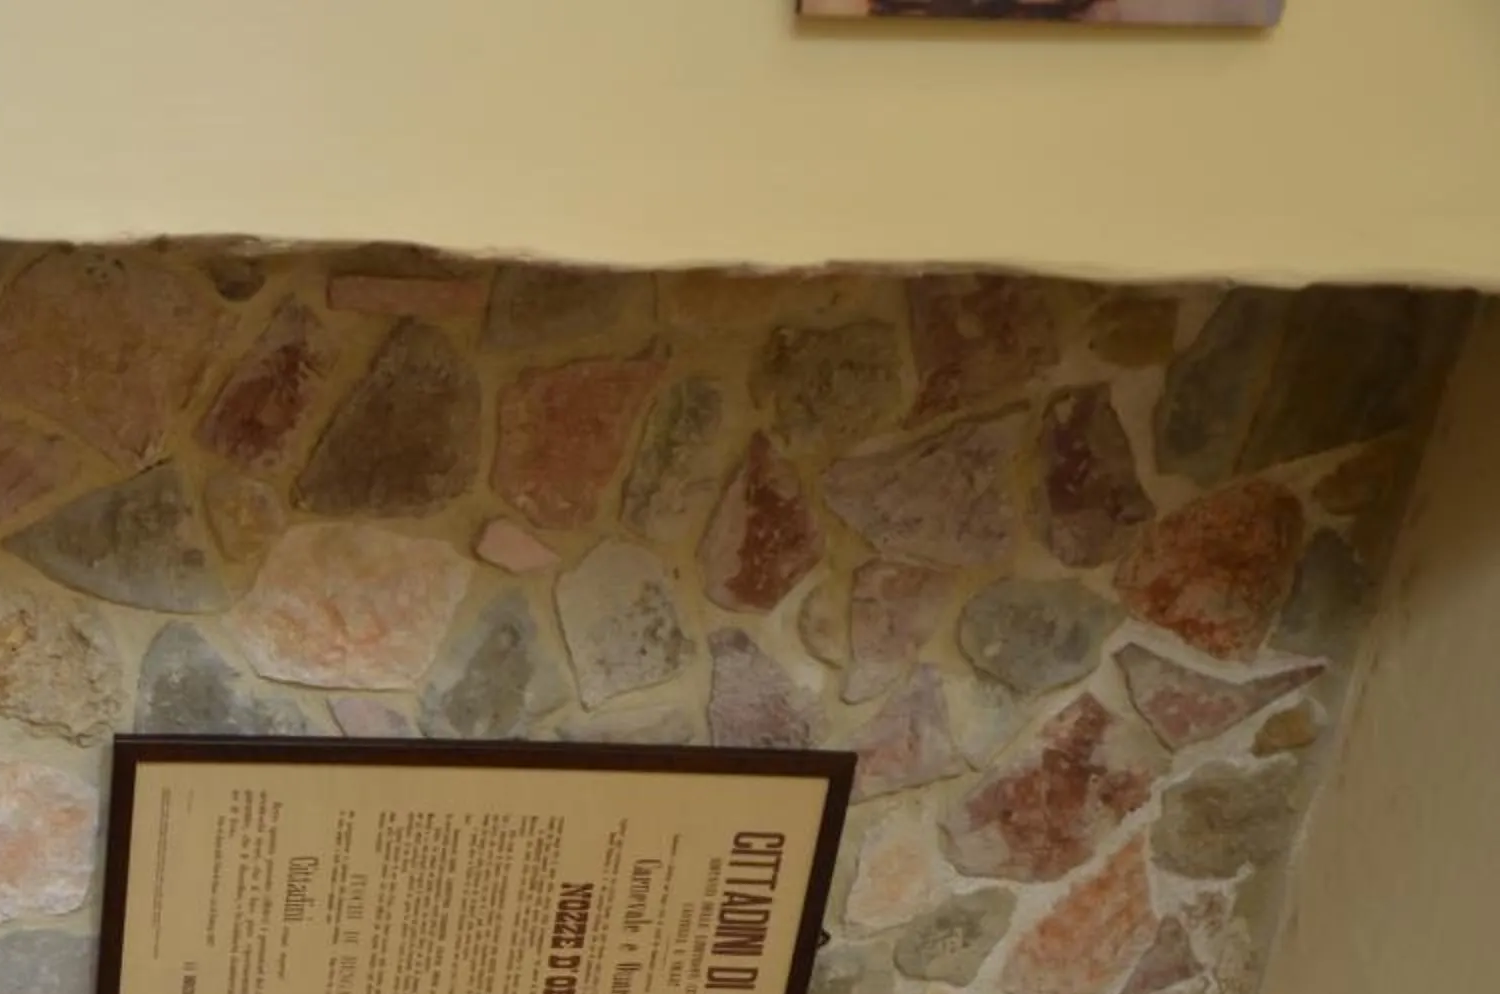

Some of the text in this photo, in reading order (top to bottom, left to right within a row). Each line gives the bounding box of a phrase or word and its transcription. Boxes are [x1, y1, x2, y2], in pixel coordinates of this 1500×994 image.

[284, 857, 319, 921] Cittadini
[551, 882, 594, 949] NOZZE
[623, 858, 662, 933] Carnevale
[711, 831, 785, 957] CITTADINI
[618, 943, 634, 952] e
[704, 966, 759, 990] DI
